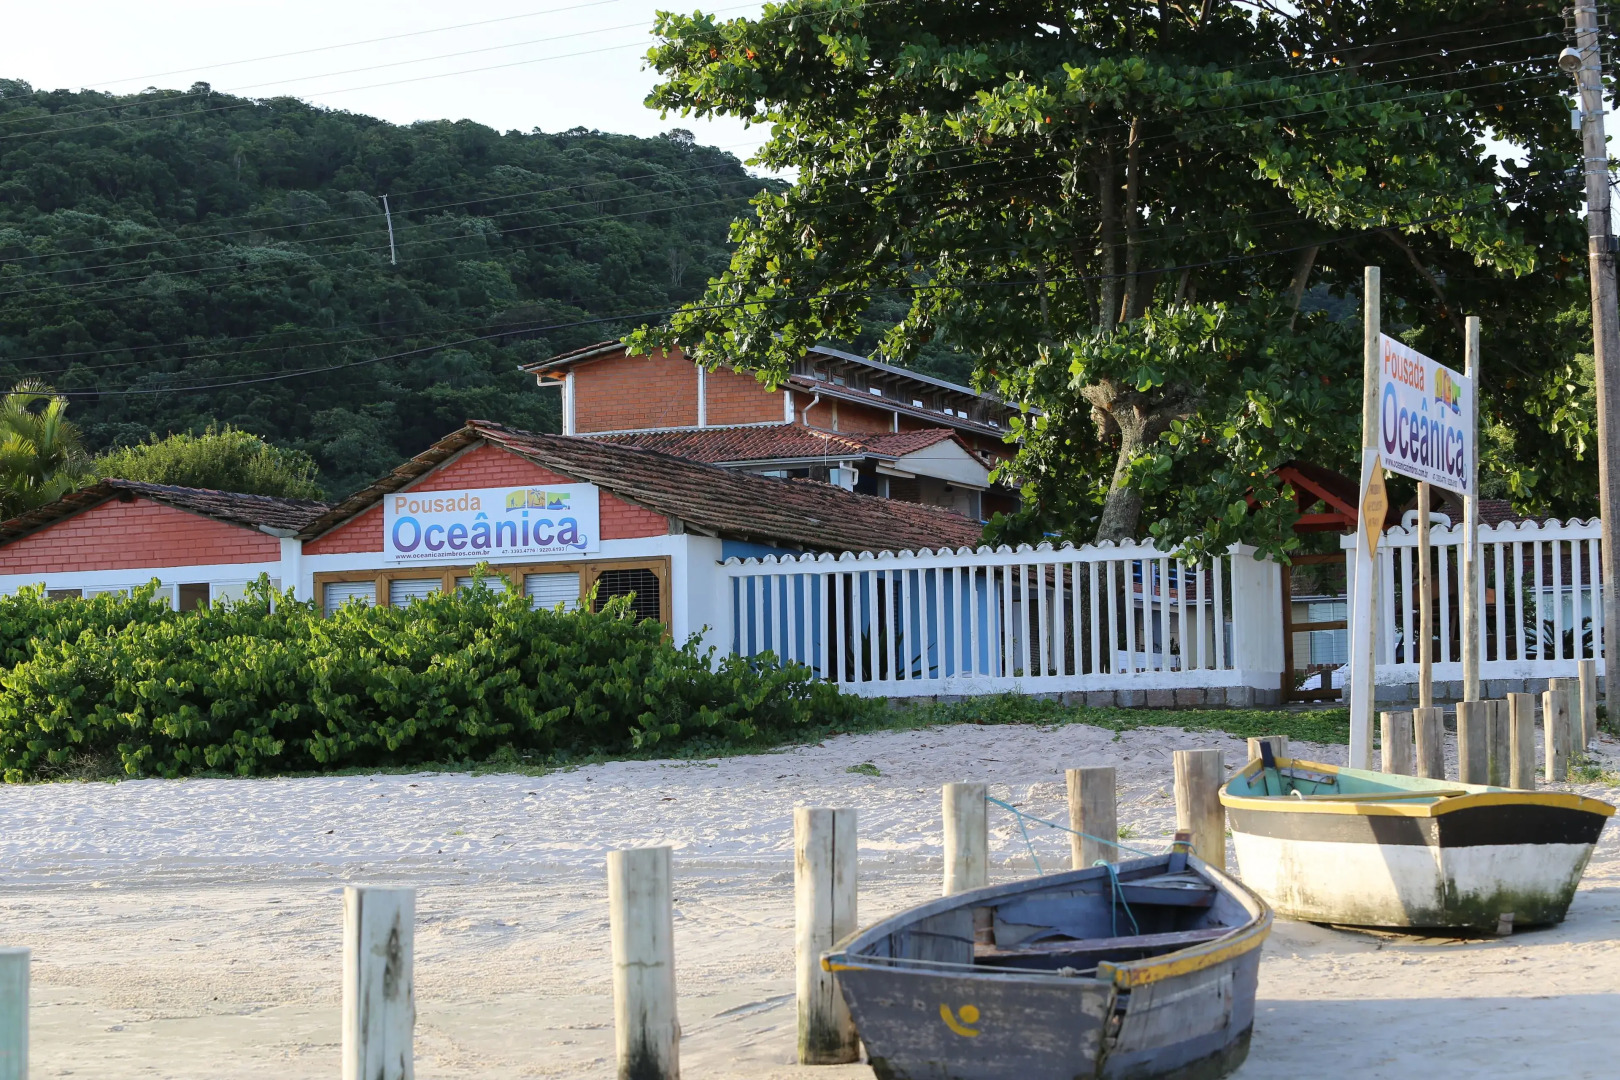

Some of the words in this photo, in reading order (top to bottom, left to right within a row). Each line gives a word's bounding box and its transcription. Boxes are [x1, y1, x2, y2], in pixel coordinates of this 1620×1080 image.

[1384, 340, 1425, 392] Pousada
[1382, 381, 1465, 478] Oceânica
[394, 493, 481, 514] Pousada
[392, 510, 579, 552] Oceânica
[395, 550, 490, 559] www.oceanicazimbros.com.br
